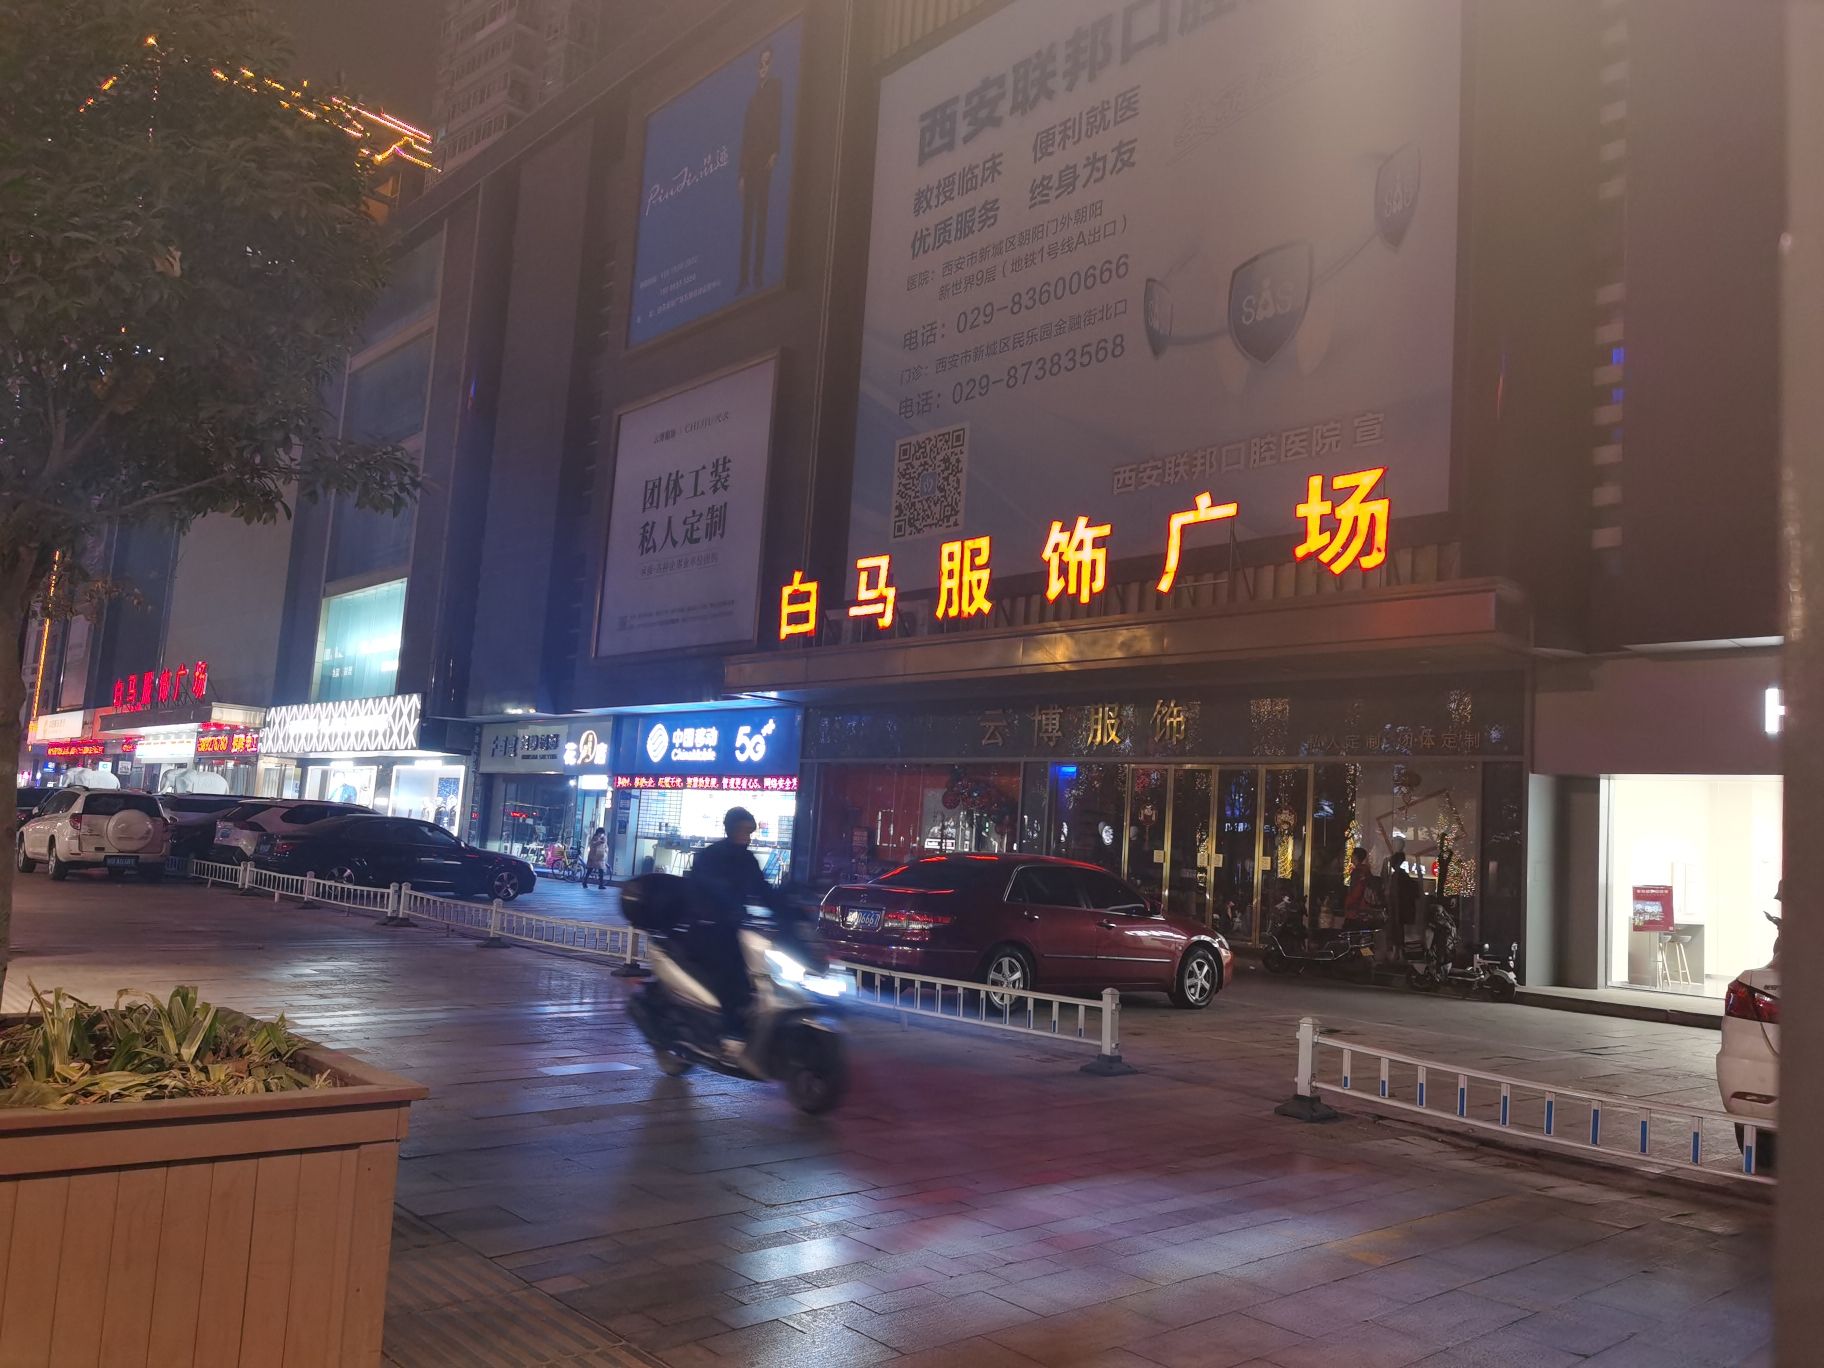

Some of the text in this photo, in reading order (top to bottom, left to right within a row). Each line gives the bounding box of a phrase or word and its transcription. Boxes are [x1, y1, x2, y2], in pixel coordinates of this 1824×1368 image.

[912, 151, 1004, 217] 教授临床
[1032, 84, 1141, 164] 便利就医
[910, 137, 1138, 260] 优质服务 终身为友
[642, 455, 732, 514] 团体工装
[1112, 410, 1385, 496] 西安联邦口腔医院 宣
[638, 502, 728, 557] 私人定制
[779, 466, 1392, 640] 白马服饰广场
[978, 699, 1188, 748] 云博服饰
